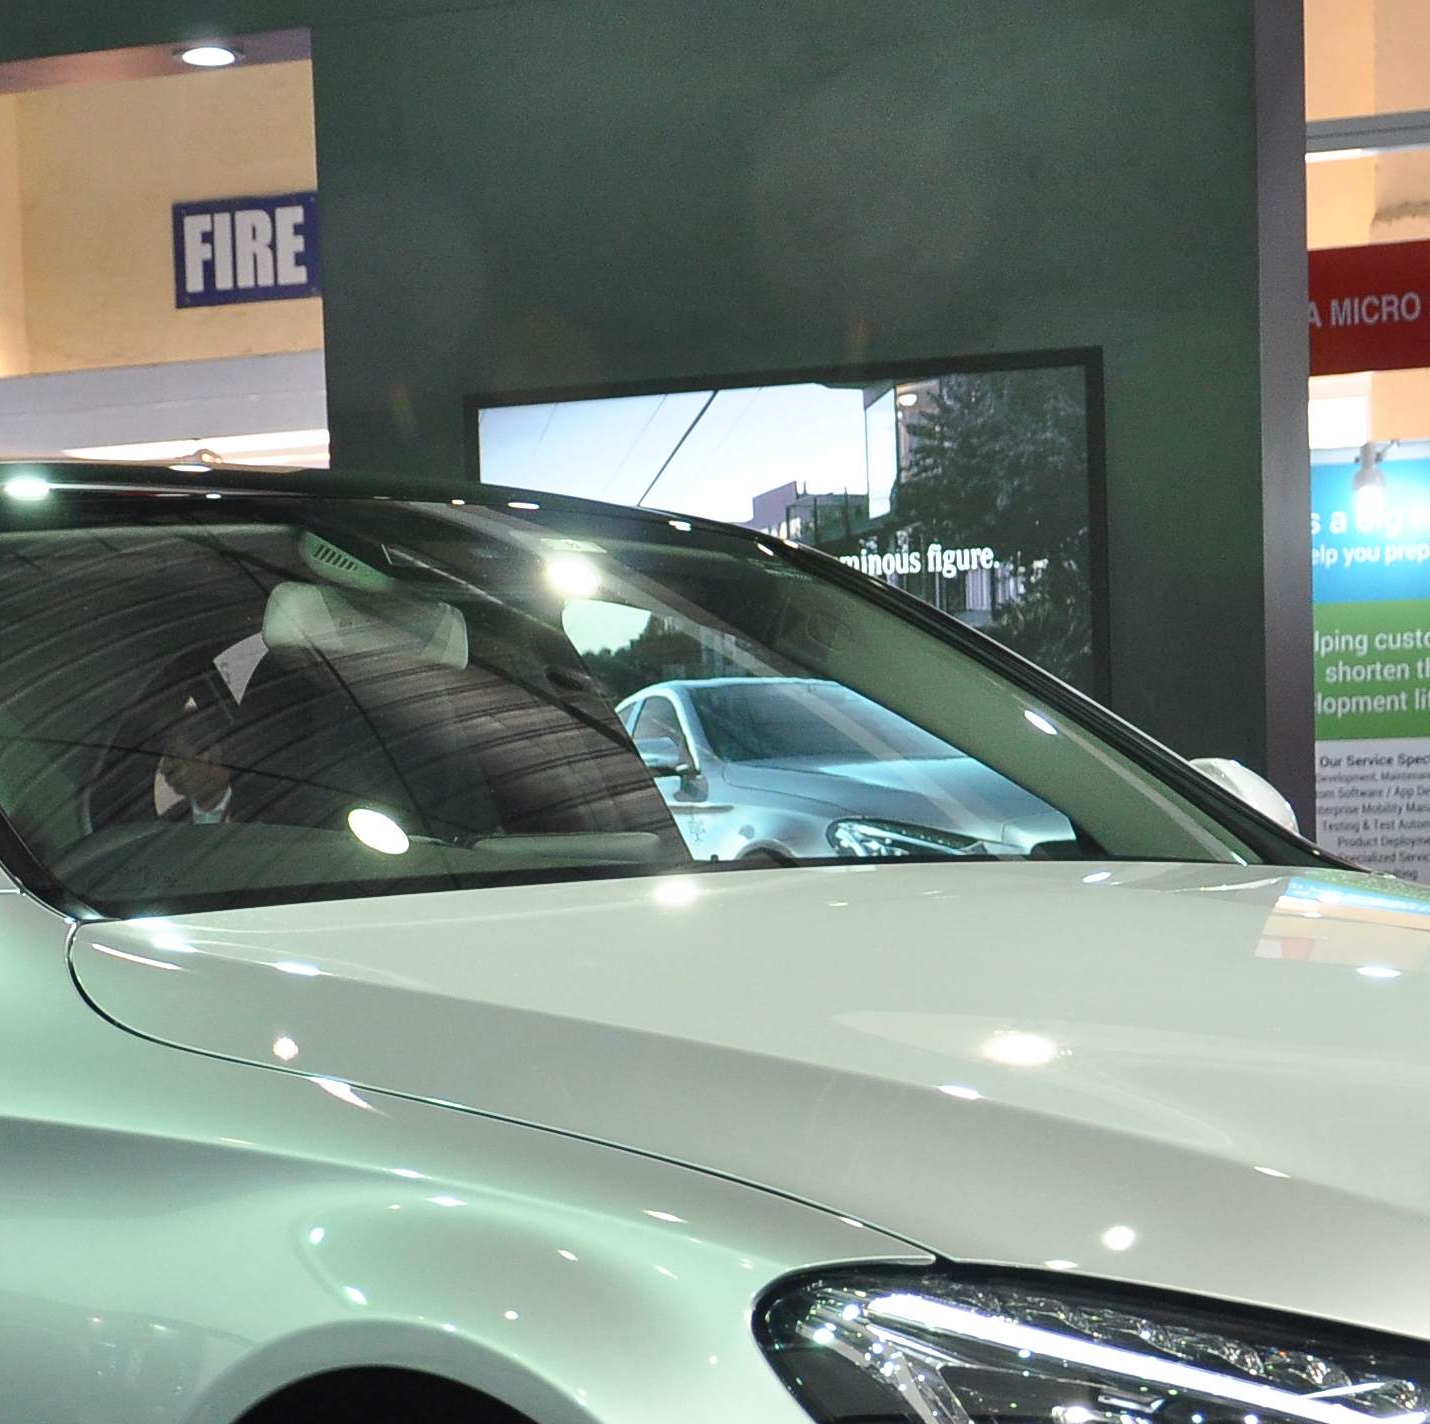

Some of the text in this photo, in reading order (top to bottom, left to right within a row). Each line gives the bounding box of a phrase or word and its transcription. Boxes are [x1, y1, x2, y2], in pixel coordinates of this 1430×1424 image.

[183, 205, 308, 293] FIRE
[1331, 292, 1422, 327] MICRO
[927, 543, 999, 578] figure.
[1312, 545, 1338, 567] elp
[1343, 544, 1381, 567] you
[1314, 630, 1368, 657] lping
[1325, 660, 1409, 683] shorten
[1315, 690, 1407, 717] lopment
[1320, 756, 1343, 767] Our
[1347, 753, 1394, 767] Service
